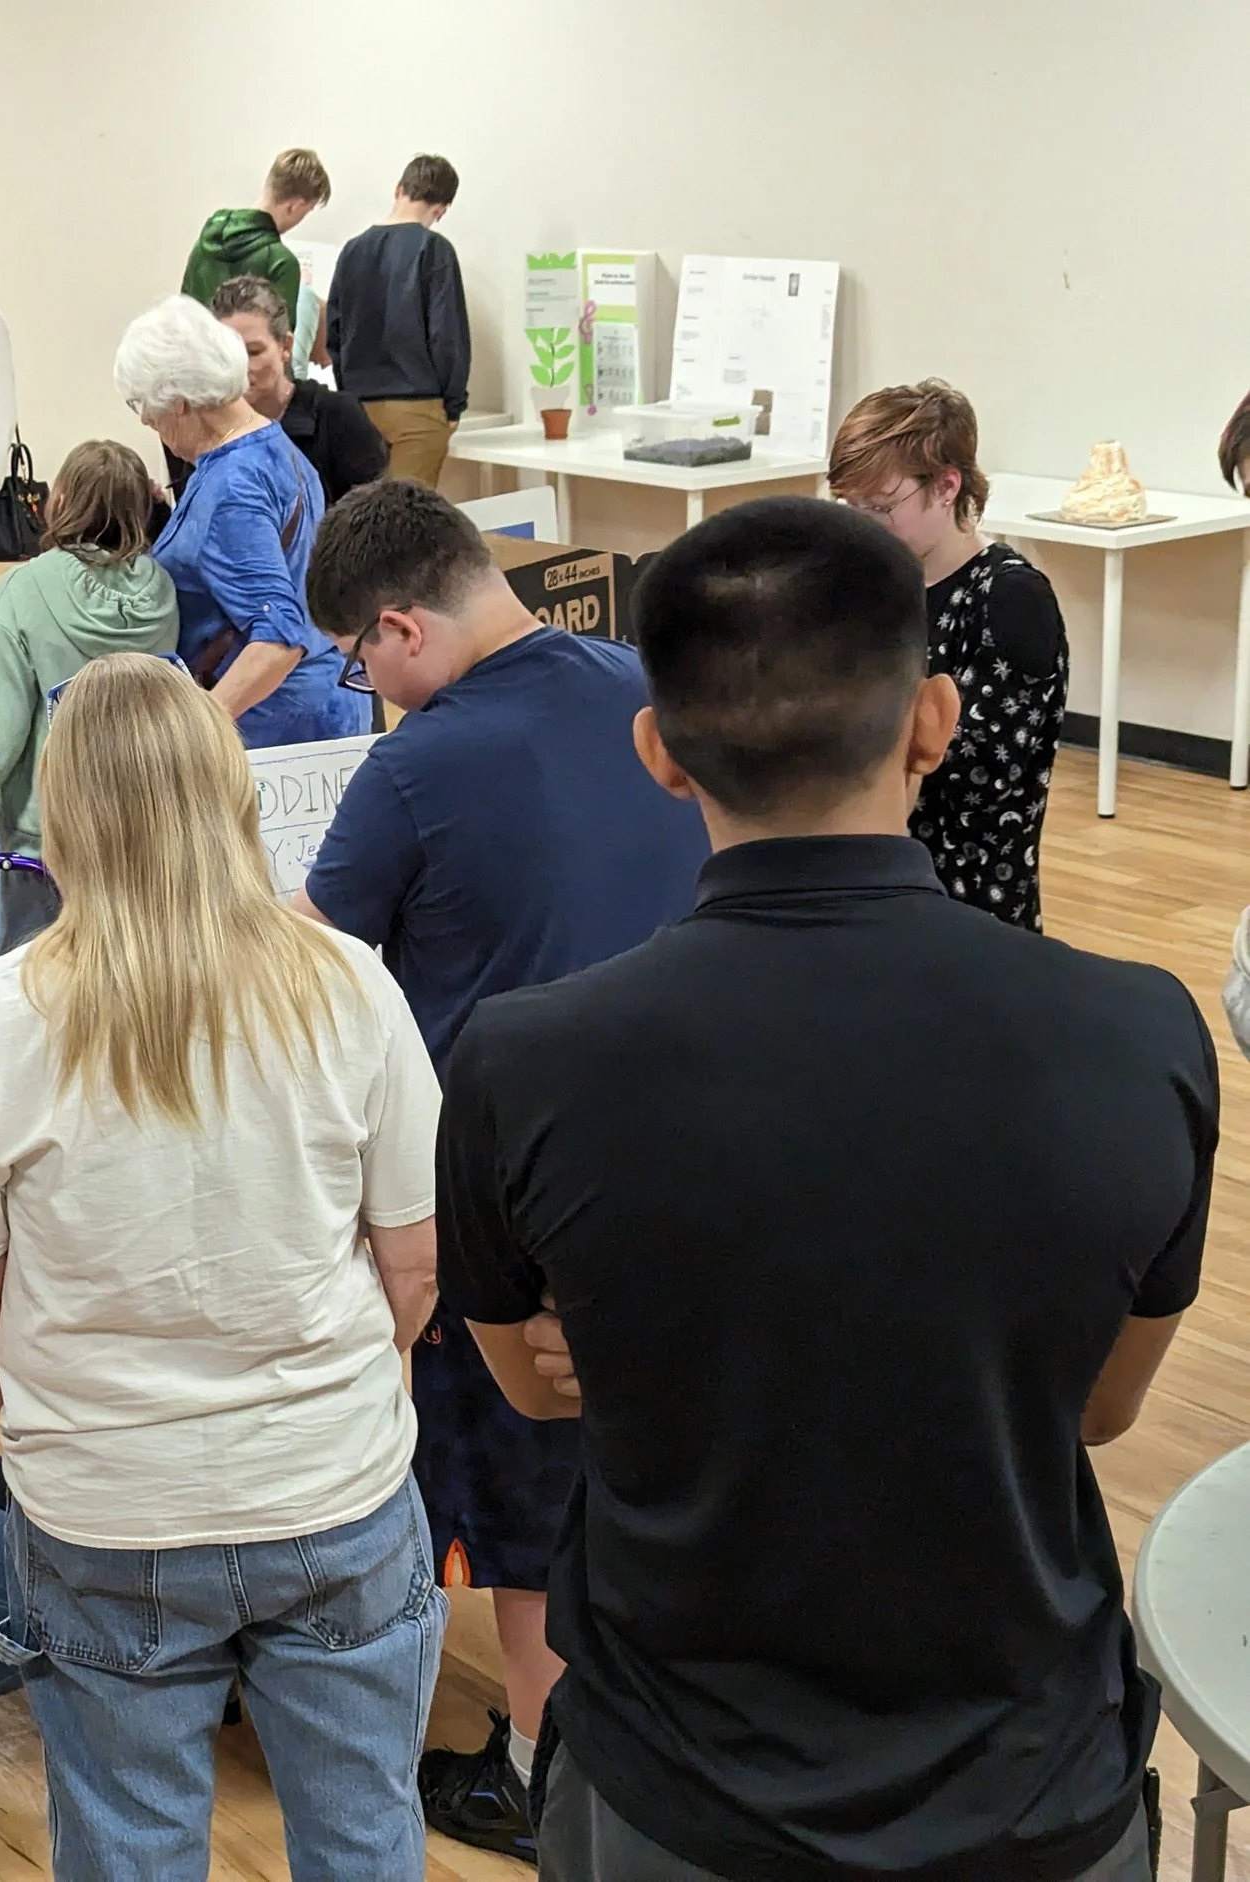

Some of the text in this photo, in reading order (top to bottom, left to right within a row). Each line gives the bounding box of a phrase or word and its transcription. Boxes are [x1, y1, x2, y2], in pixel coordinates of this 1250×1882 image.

[547, 569, 559, 588] 28
[565, 564, 578, 583] 44
[533, 594, 601, 633] OARD
[295, 834, 318, 862] Je
